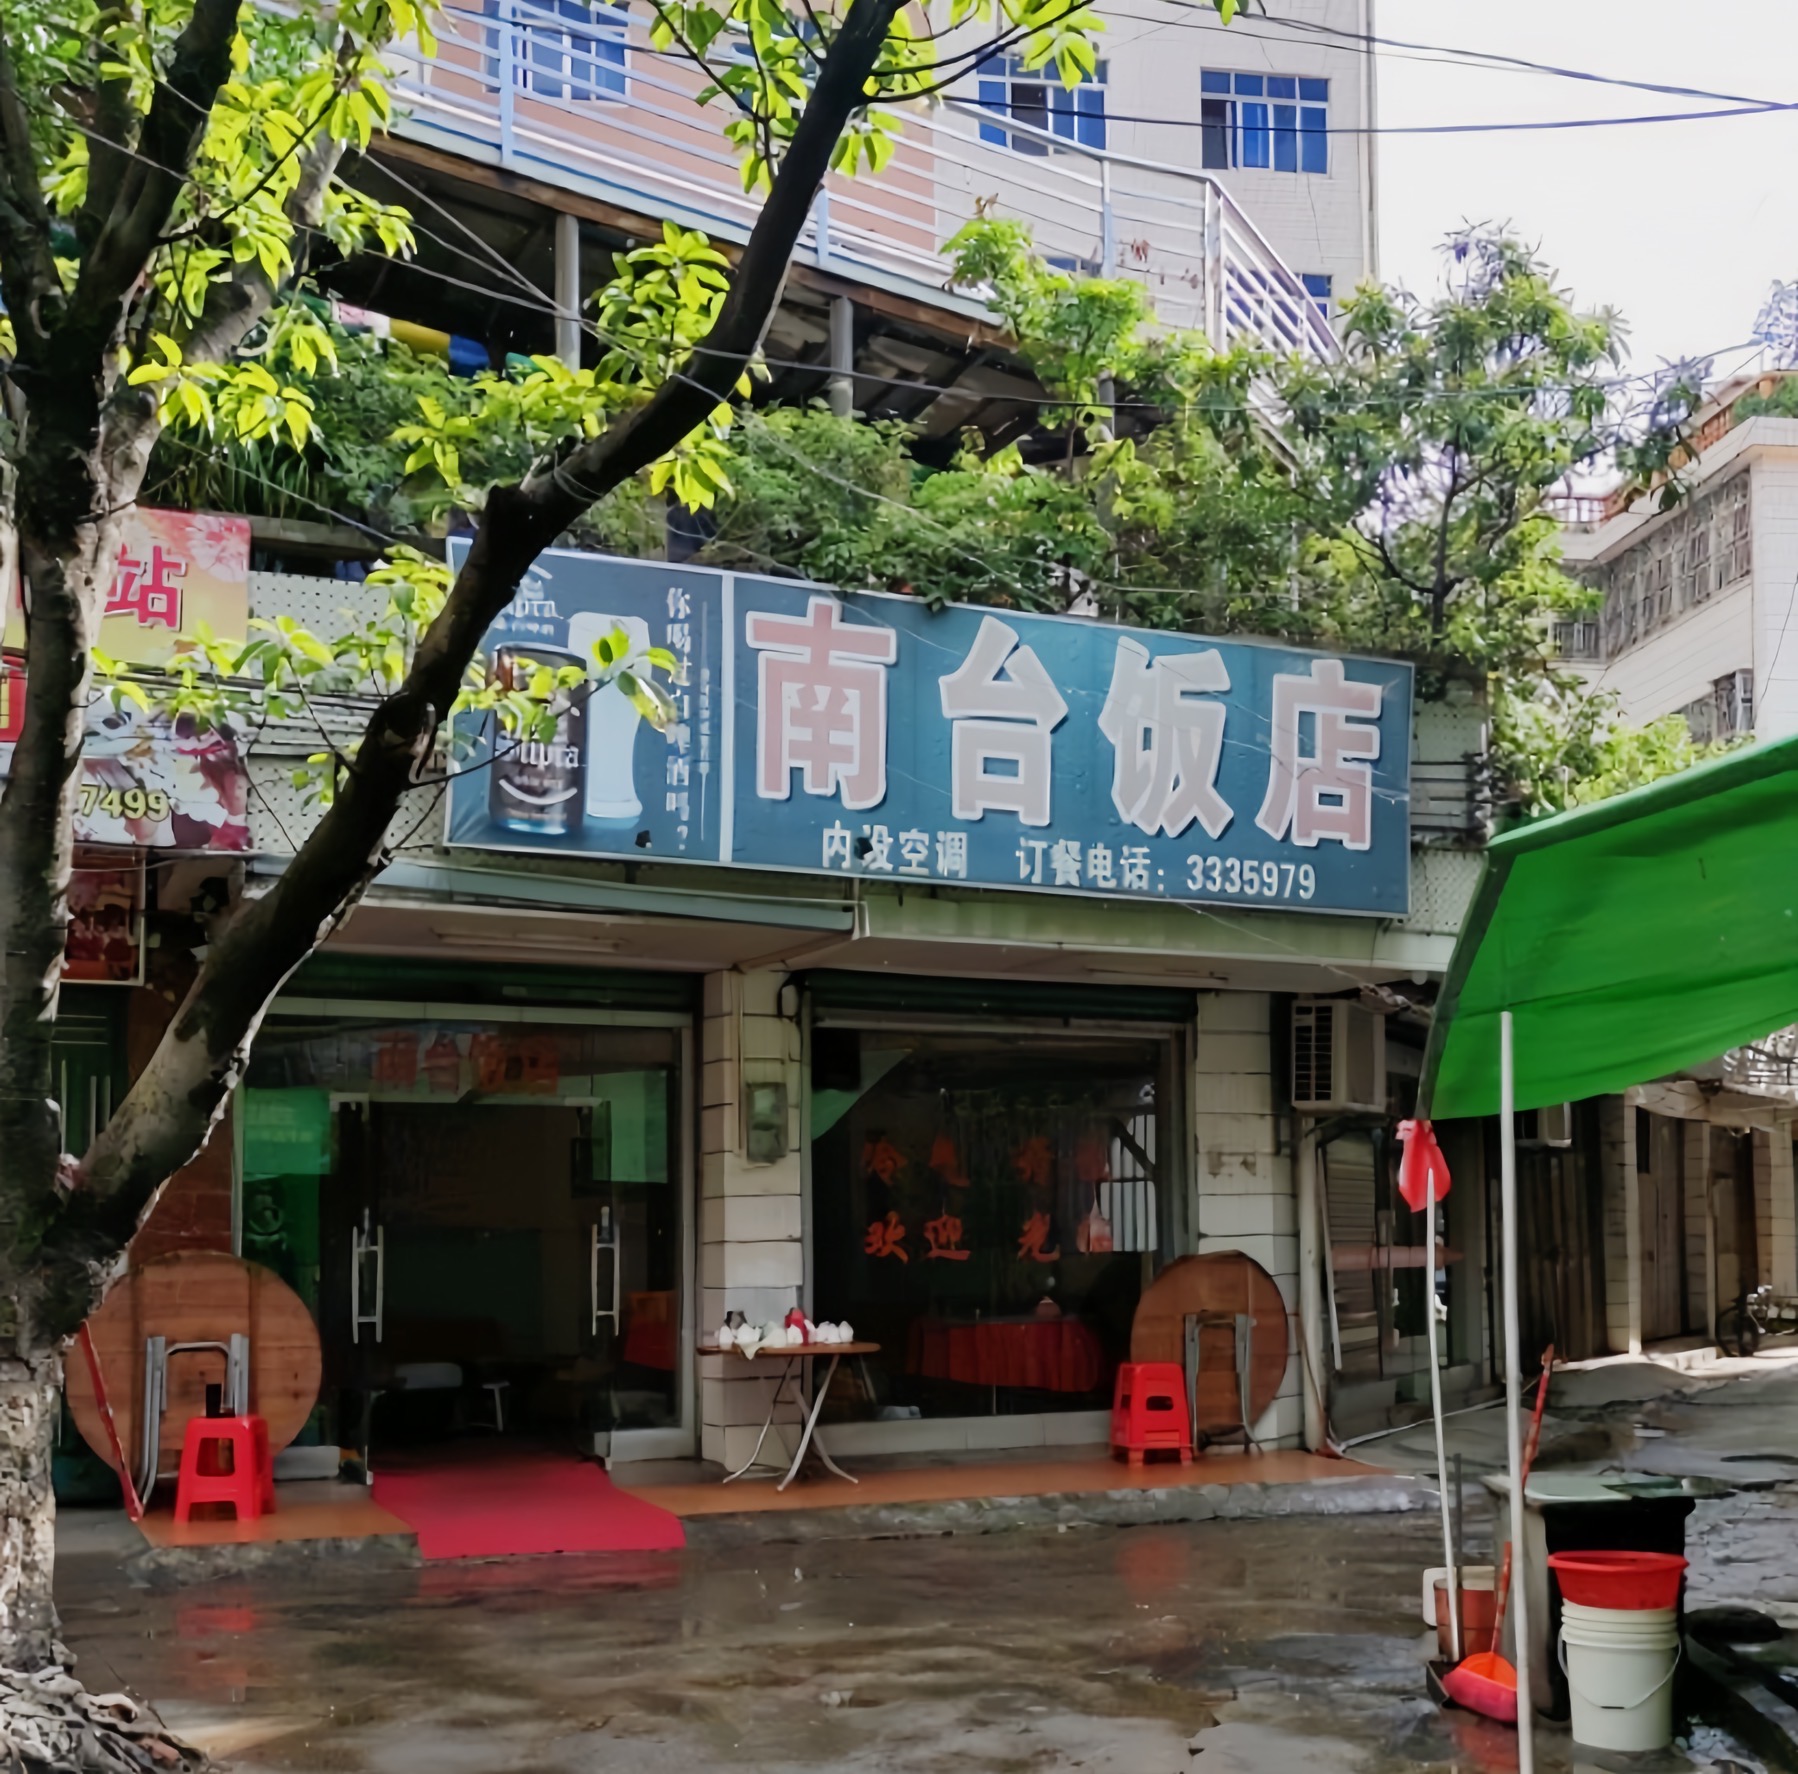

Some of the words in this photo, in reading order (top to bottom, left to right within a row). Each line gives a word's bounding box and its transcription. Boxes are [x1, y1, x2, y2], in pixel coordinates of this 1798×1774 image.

[745, 595, 1383, 851] 南台饭店
[80, 782, 170, 822] 7499
[822, 819, 968, 879] 内设空调
